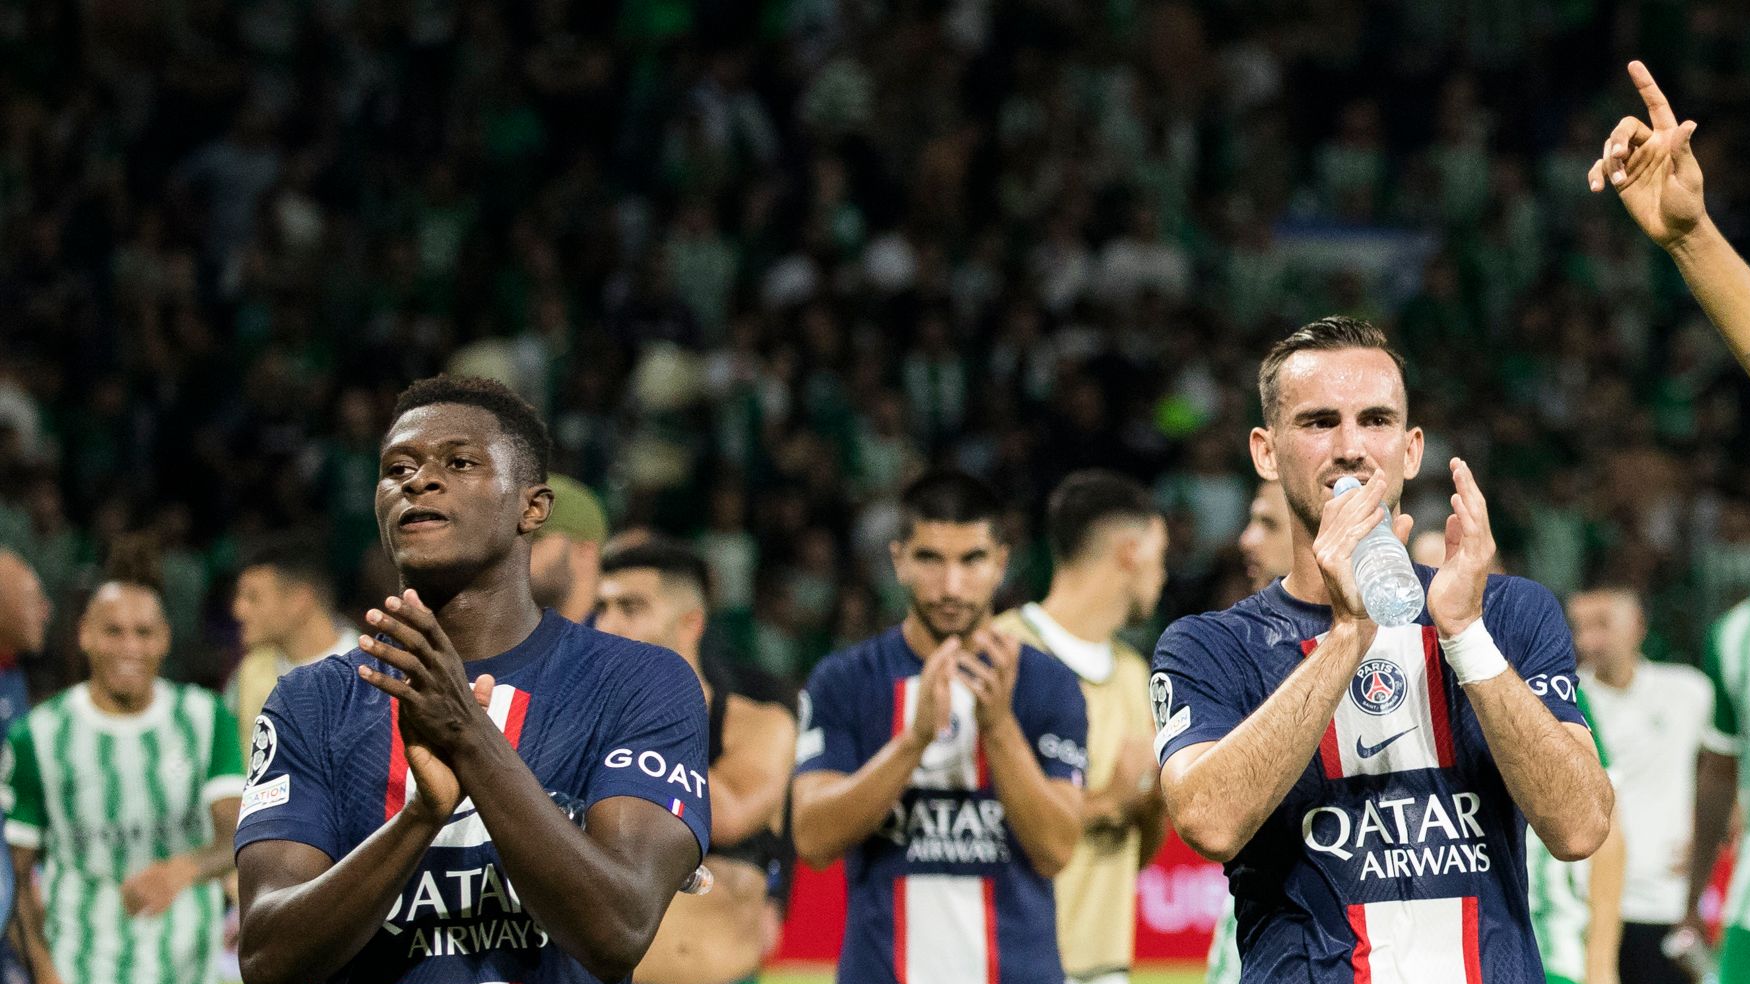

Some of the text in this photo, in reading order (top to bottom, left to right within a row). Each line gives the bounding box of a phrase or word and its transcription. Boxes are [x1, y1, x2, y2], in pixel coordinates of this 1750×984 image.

[1357, 663, 1393, 678] PARIS
[1525, 673, 1577, 703] GO
[604, 748, 706, 799] GOAT
[1302, 792, 1486, 861] QATAR
[1360, 843, 1491, 881] AIRWAYS
[382, 863, 522, 936] ATA
[408, 919, 549, 959] AIRWAYS
